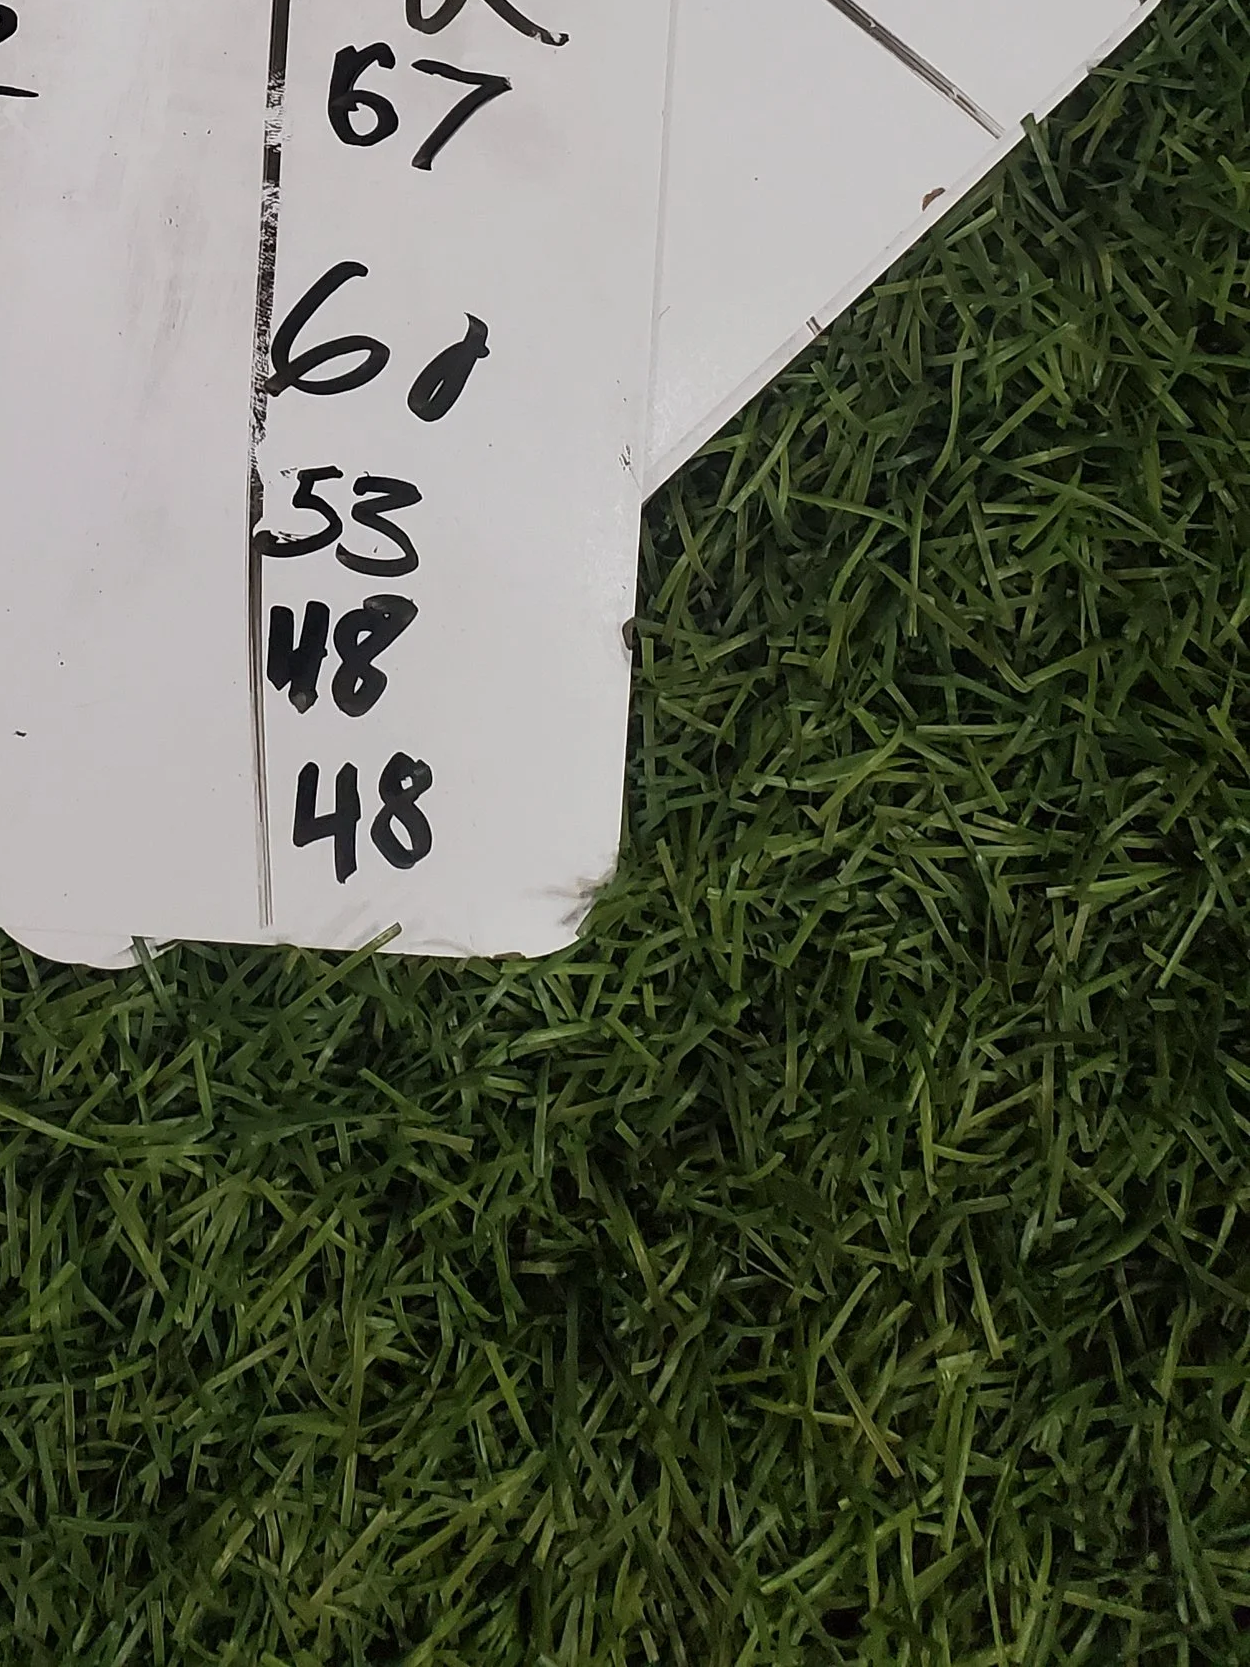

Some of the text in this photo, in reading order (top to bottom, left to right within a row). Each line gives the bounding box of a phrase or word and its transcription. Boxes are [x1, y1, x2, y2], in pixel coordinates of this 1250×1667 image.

[327, 42, 513, 172] 67
[255, 464, 425, 579] 53
[267, 593, 419, 718] 48
[292, 751, 433, 884] 48
